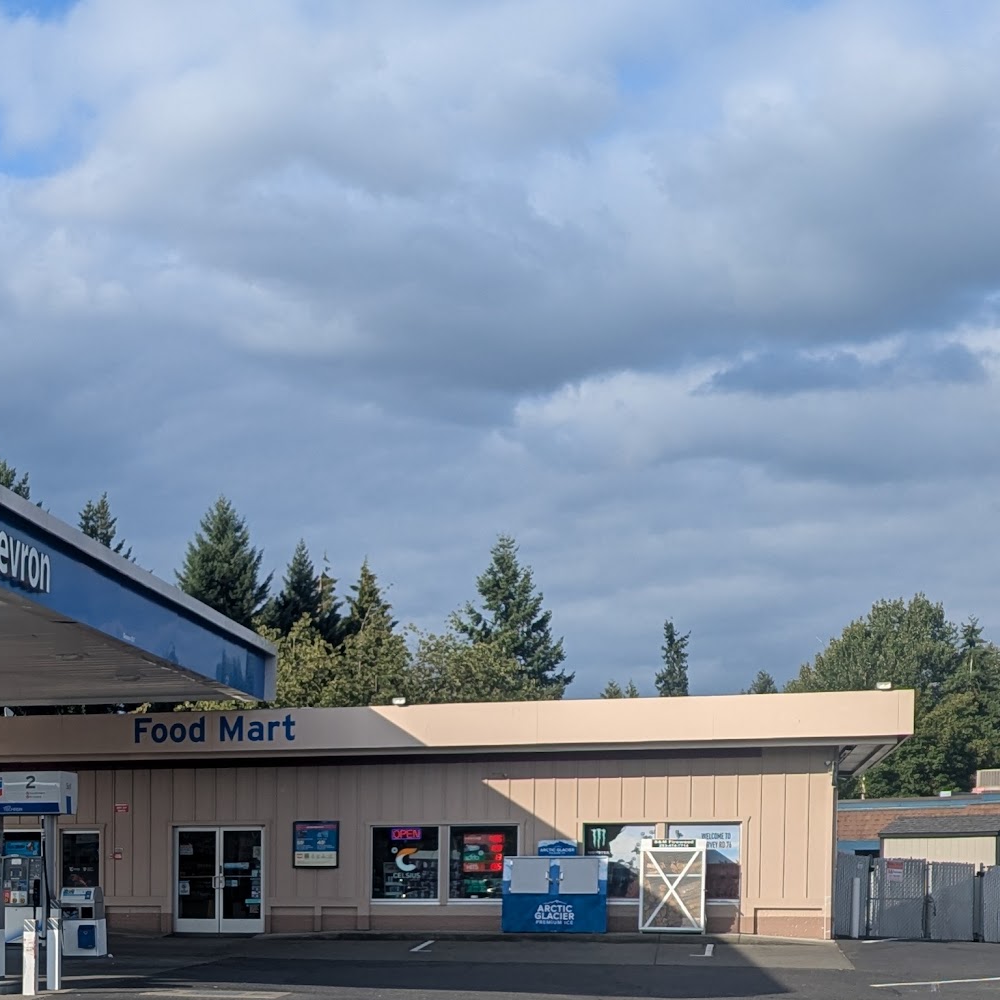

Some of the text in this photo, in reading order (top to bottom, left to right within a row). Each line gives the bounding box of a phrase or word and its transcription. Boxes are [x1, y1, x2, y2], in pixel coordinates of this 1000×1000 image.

[134, 714, 296, 743] Food Mart
[25, 776, 36, 789] 2
[392, 829, 421, 838] OPEN
[537, 905, 573, 913] ARCTIC
[534, 912, 575, 920] GLACIER
